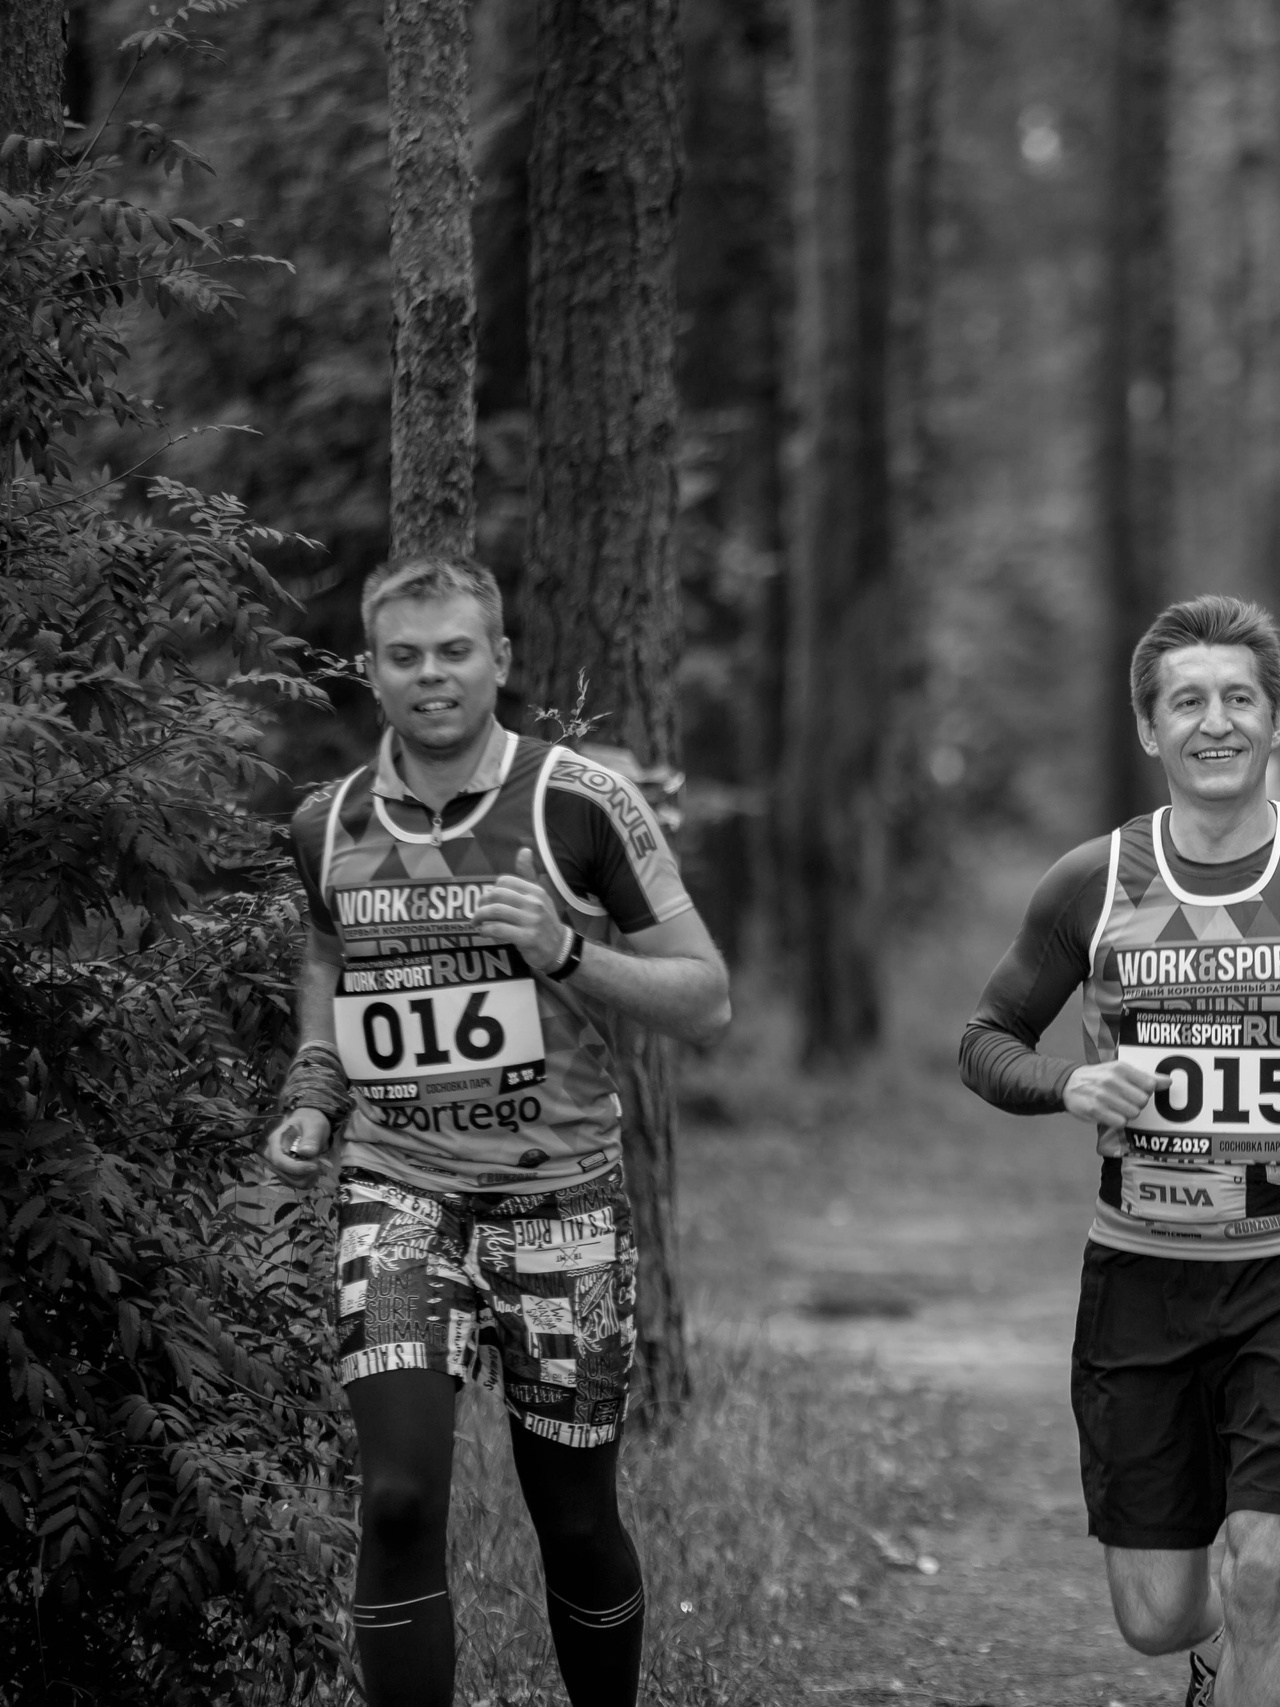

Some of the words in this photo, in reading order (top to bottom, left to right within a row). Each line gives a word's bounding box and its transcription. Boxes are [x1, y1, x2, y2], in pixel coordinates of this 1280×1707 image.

[549, 760, 657, 860] ZONE
[336, 884, 495, 926] WORK&SPO
[344, 965, 432, 993] WORK&SPORT
[432, 948, 513, 985] RUN
[1168, 982, 1267, 996] КОРПОРАТИВНЫЙ
[1137, 1012, 1213, 1023] КОРПОРАТИВНЫЙ
[1215, 1014, 1242, 1024] ЗАБЕГ
[361, 991, 505, 1071] 016
[1136, 1022, 1242, 1046] WORK&SPORT
[426, 1080, 469, 1094] СОСНОВКА
[470, 1077, 492, 1090] ПАРК
[1133, 1134, 1210, 1154] 14.07.2019
[1219, 1140, 1262, 1153] СОСНОВКА
[1139, 1182, 1214, 1207] SILVA
[515, 1219, 552, 1247] RIDE
[368, 1274, 411, 1299] SUN
[365, 1295, 419, 1325] SURF
